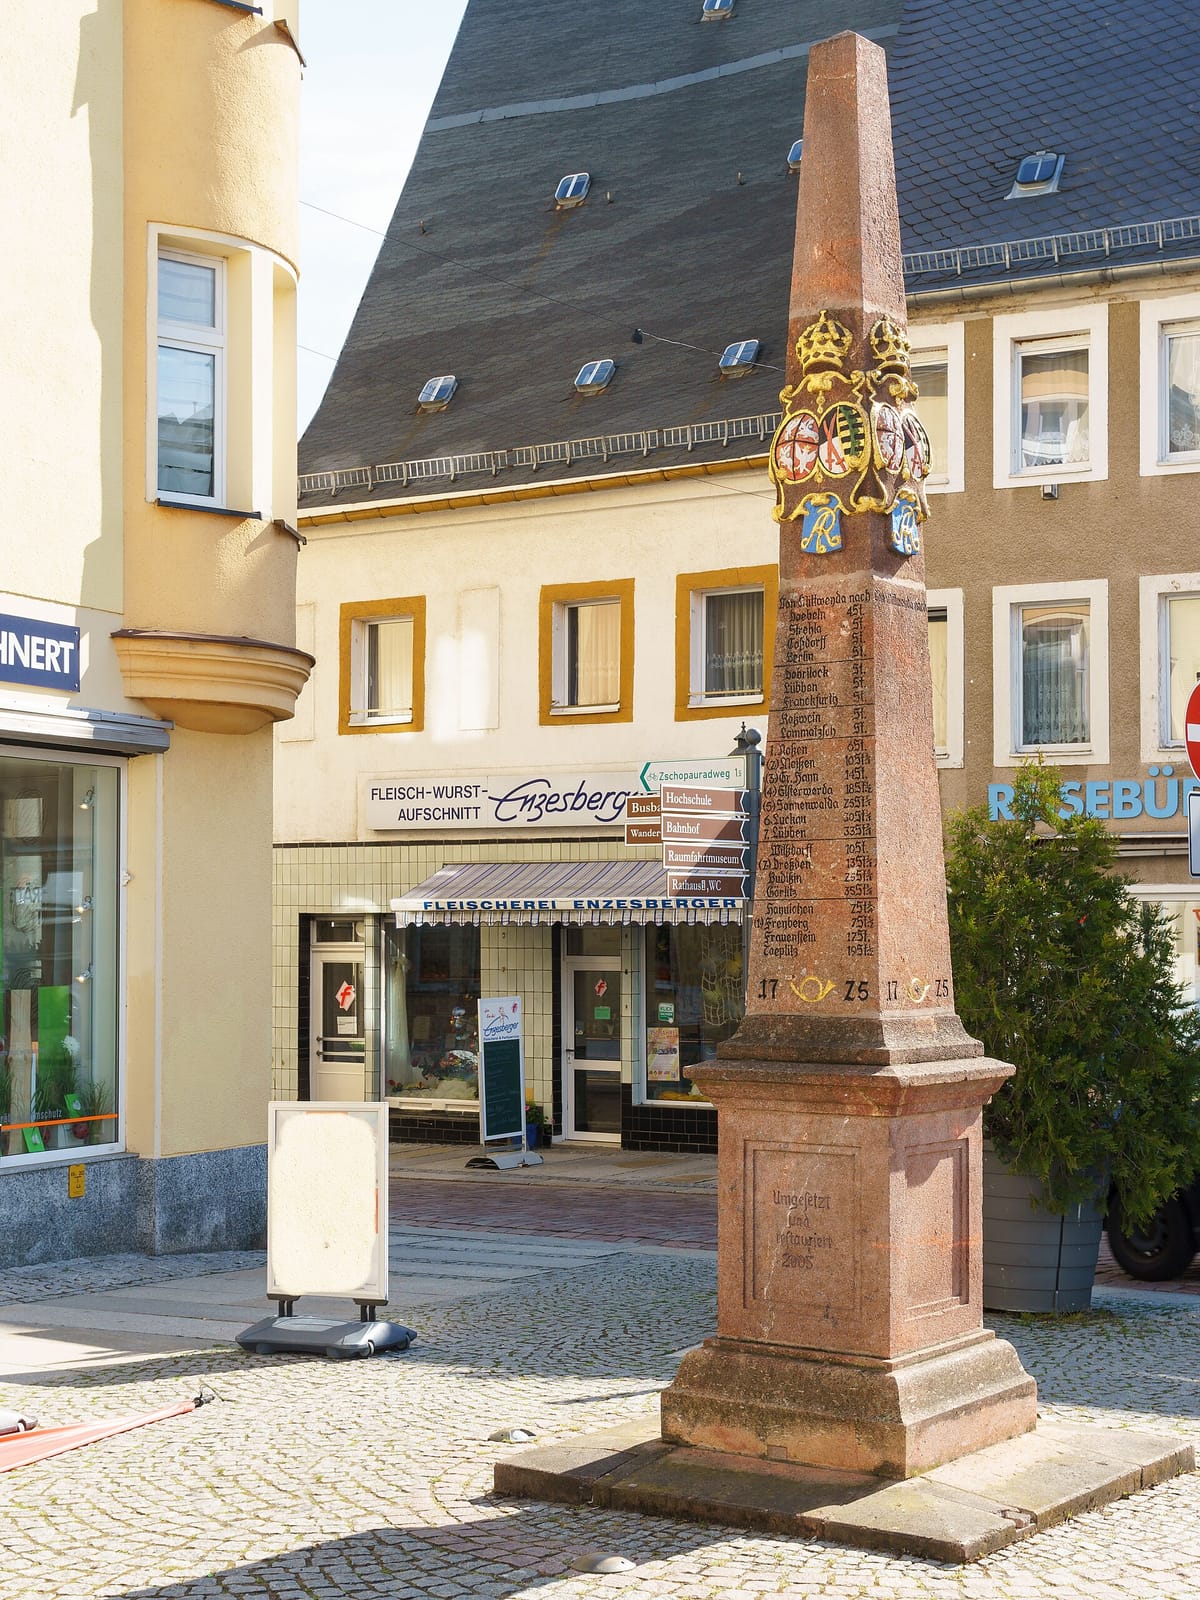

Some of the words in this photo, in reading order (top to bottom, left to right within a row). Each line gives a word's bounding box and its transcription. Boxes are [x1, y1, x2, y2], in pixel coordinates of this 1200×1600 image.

[849, 589, 871, 603] nach
[658, 769, 731, 781] Zschopauradweg
[371, 785, 488, 801] FLEISCH-WURST-
[666, 791, 712, 806] Hochschule
[988, 765, 1200, 822] RSEBÜ
[398, 806, 481, 821] AUFSCHNITT
[666, 821, 701, 834] Bahnhof
[668, 850, 740, 864] Raumfahrtmuseum
[672, 879, 702, 891] Rathaus
[423, 899, 557, 911] FLEISCHEREI
[573, 898, 737, 910] ENZESBERGER
[758, 978, 779, 1000] 17
[886, 980, 898, 1001] 17
[781, 1252, 815, 1270] 2005
